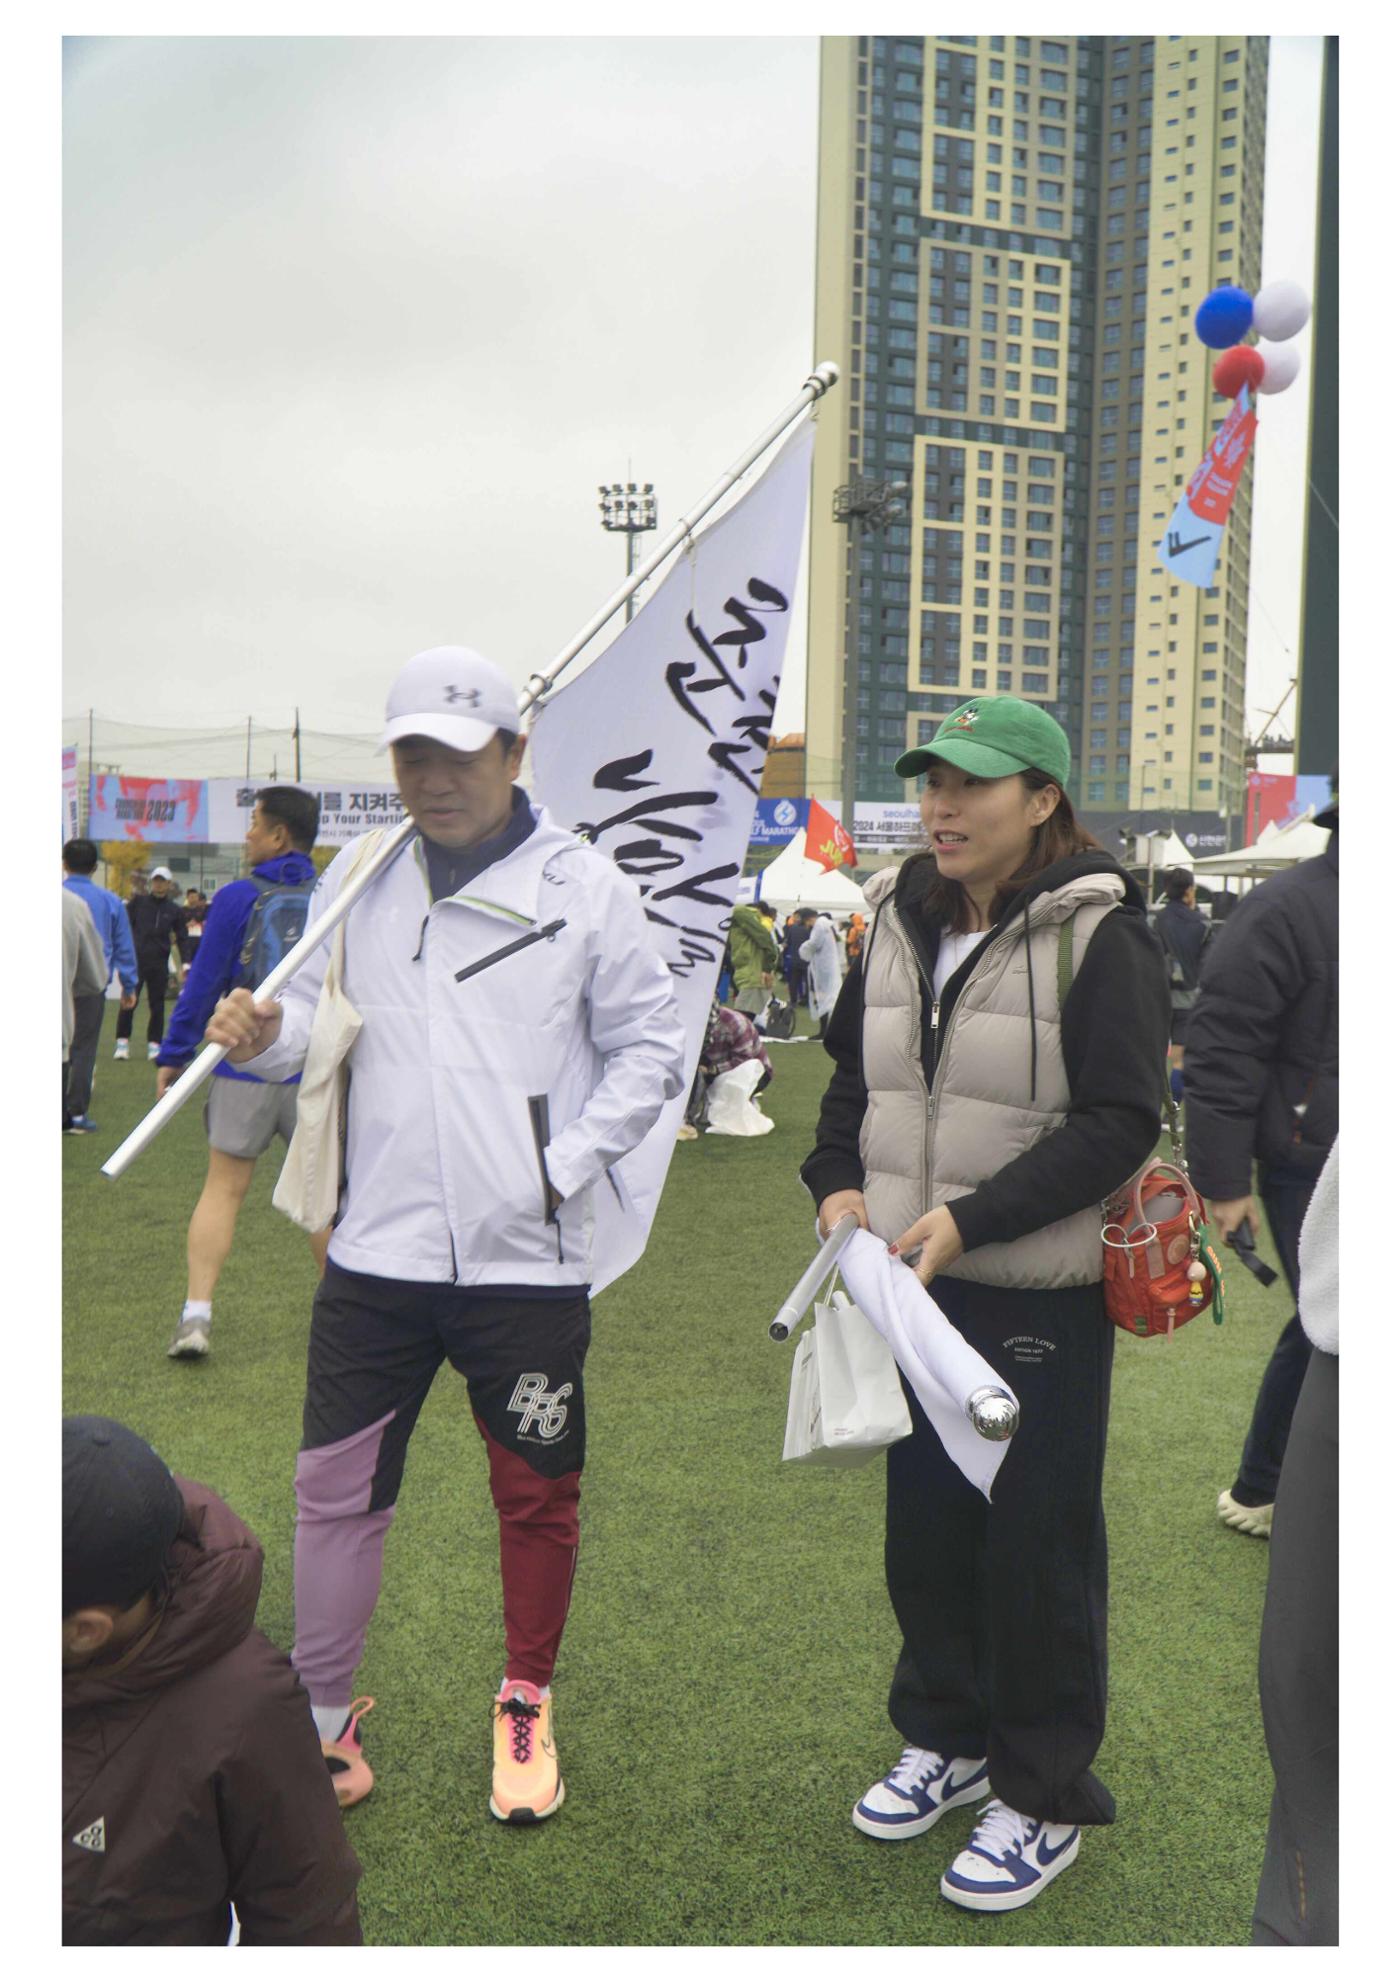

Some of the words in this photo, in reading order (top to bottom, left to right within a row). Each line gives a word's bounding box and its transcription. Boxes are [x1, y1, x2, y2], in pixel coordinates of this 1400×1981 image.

[334, 813, 361, 825] Your
[365, 813, 404, 825] Startin
[883, 808, 921, 819] seoulha
[853, 820, 874, 832] 2024
[1003, 1336, 1034, 1348] FIFTEEN
[1035, 1338, 1056, 1351] LOVE
